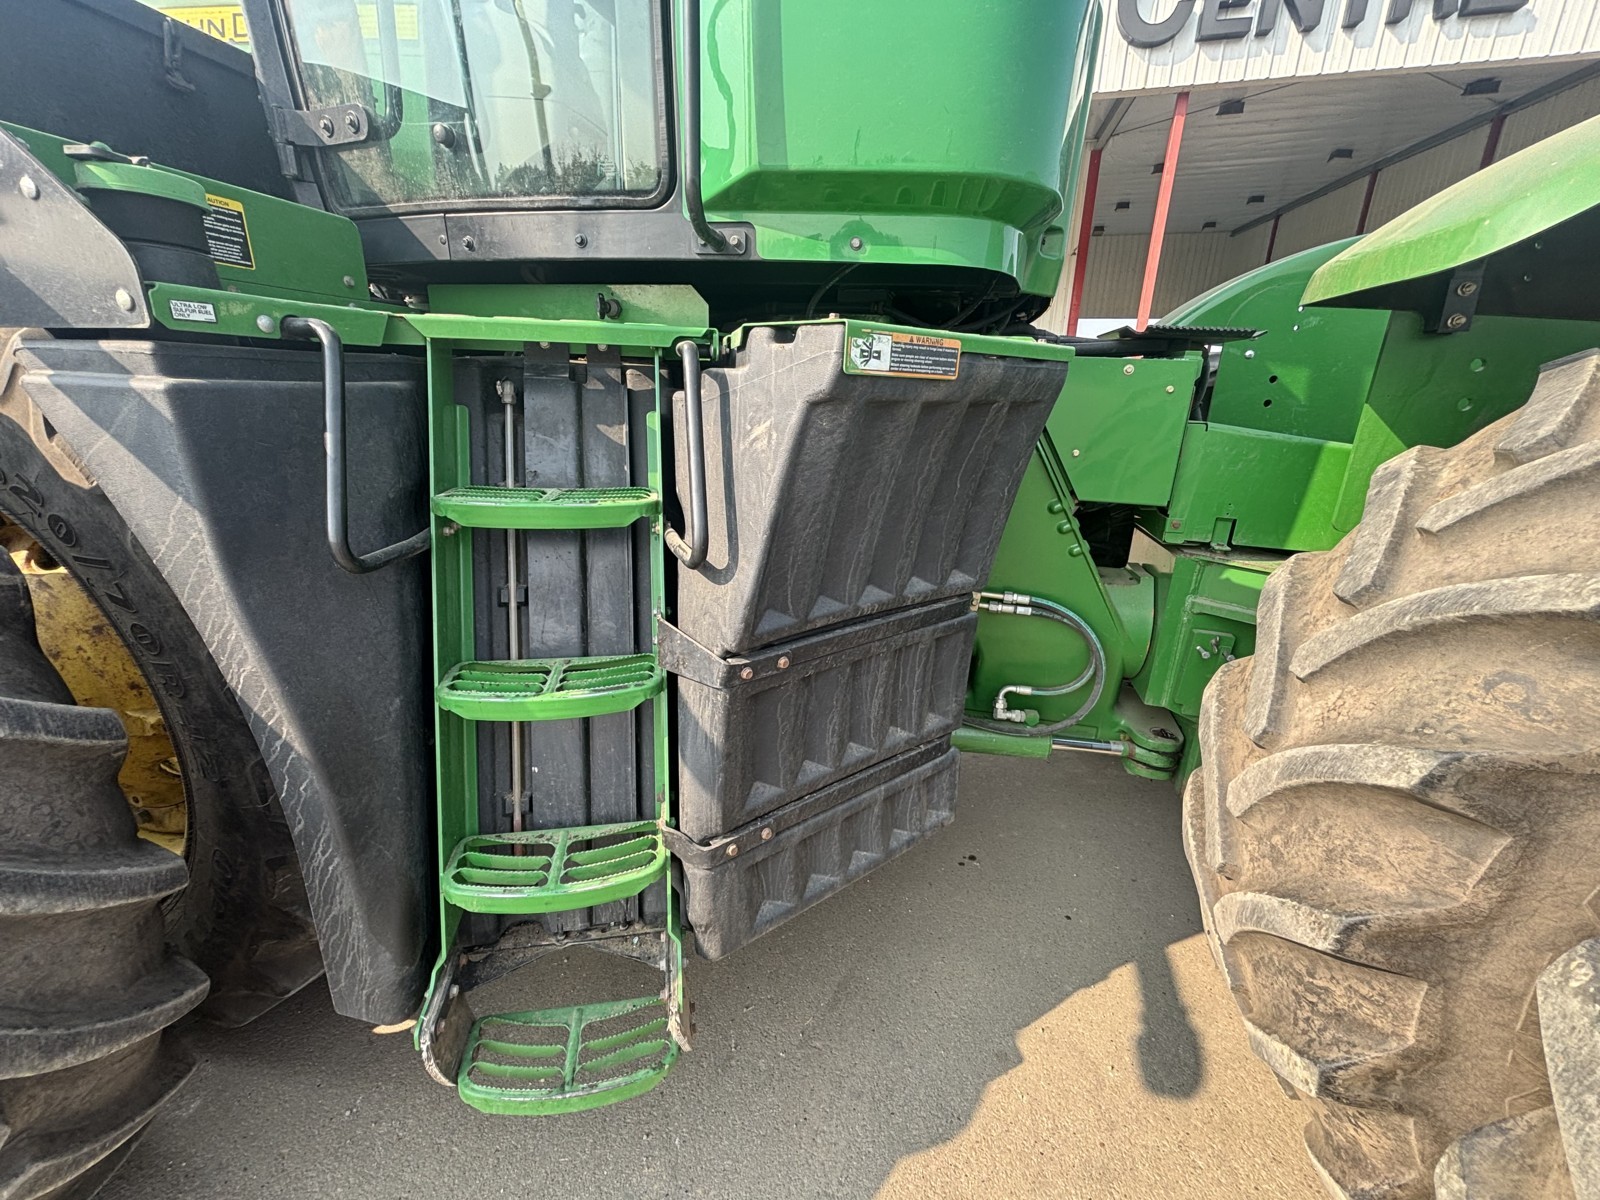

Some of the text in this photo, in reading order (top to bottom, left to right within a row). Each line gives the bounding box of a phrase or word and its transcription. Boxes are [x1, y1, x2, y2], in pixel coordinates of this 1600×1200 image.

[207, 197, 229, 207] AUTION
[171, 301, 192, 309] ULTRA
[173, 306, 197, 314] SULFUR
[915, 336, 944, 346] WARNING
